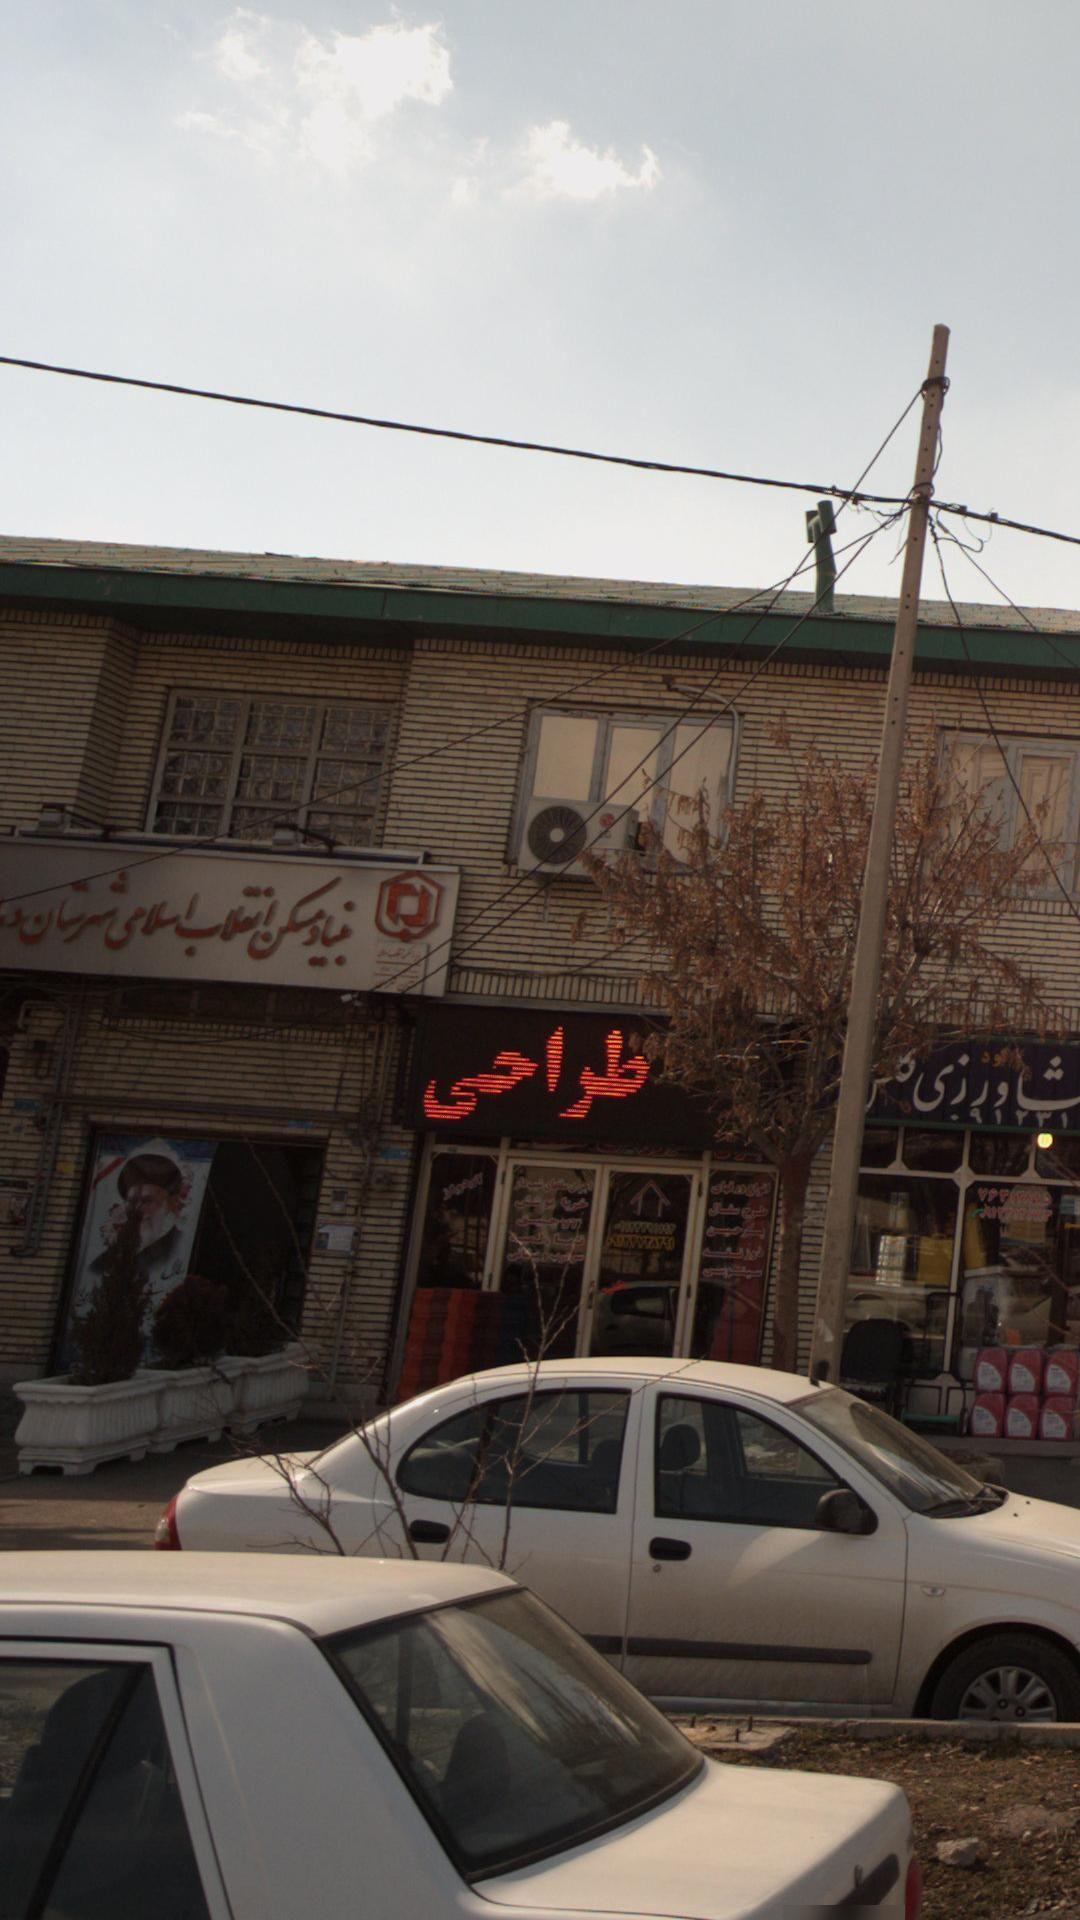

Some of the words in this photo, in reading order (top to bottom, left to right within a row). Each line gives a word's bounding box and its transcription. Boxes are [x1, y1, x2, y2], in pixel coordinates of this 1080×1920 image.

[19, 871, 128, 945] شهرستان
[105, 893, 199, 950] اسلامی
[175, 886, 279, 957] انقلاب
[247, 876, 342, 960] مسکن
[302, 900, 356, 967] بنیاد
[424, 1026, 650, 1119] طراحی
[913, 1053, 1080, 1112] شاورزی
